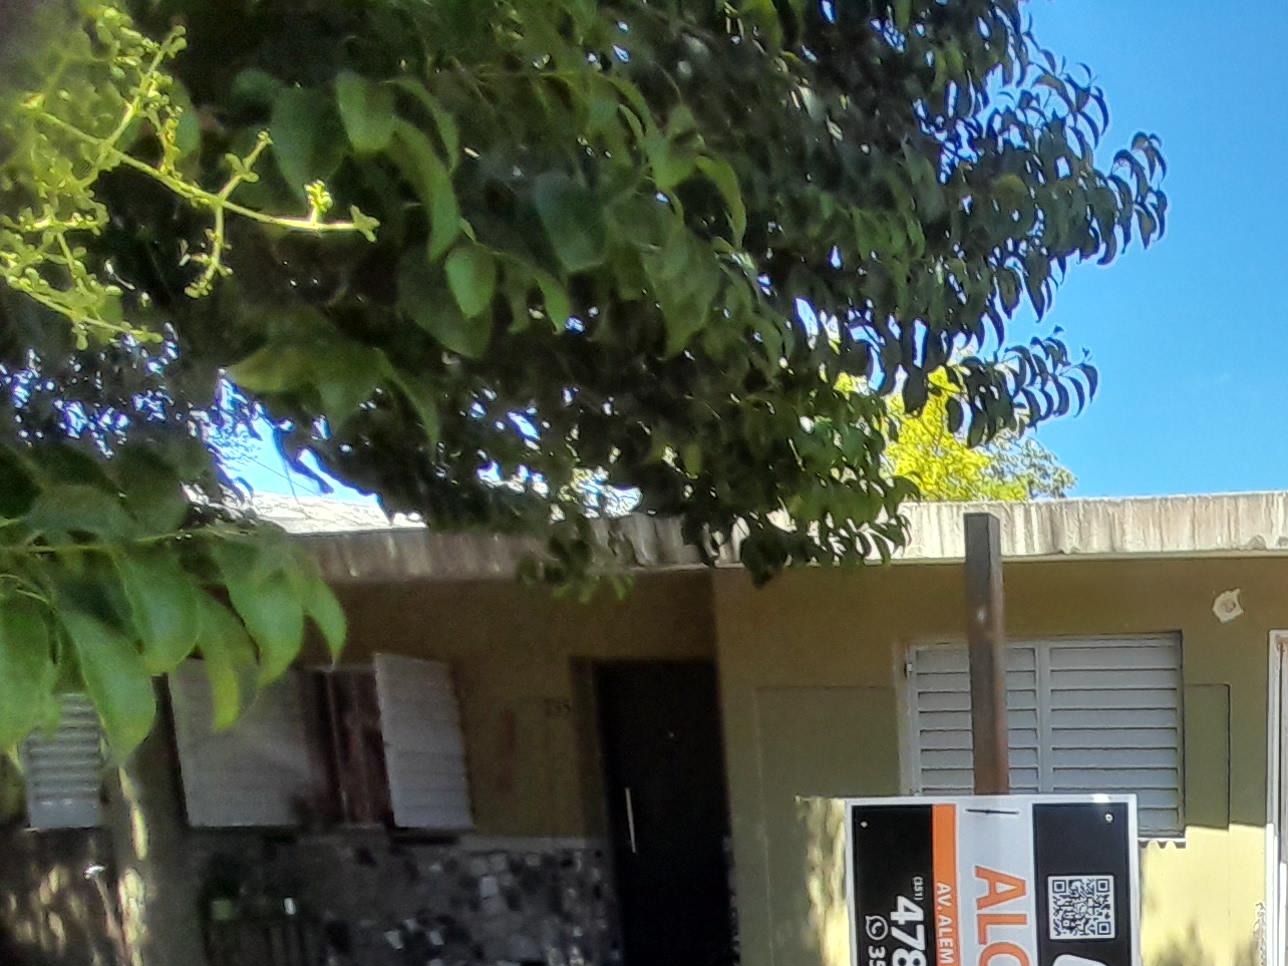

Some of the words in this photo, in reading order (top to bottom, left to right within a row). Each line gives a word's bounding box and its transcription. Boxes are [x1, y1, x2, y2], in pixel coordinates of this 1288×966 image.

[912, 876, 924, 900] (351)
[936, 882, 952, 910] AV.
[939, 915, 955, 964] ALEM
